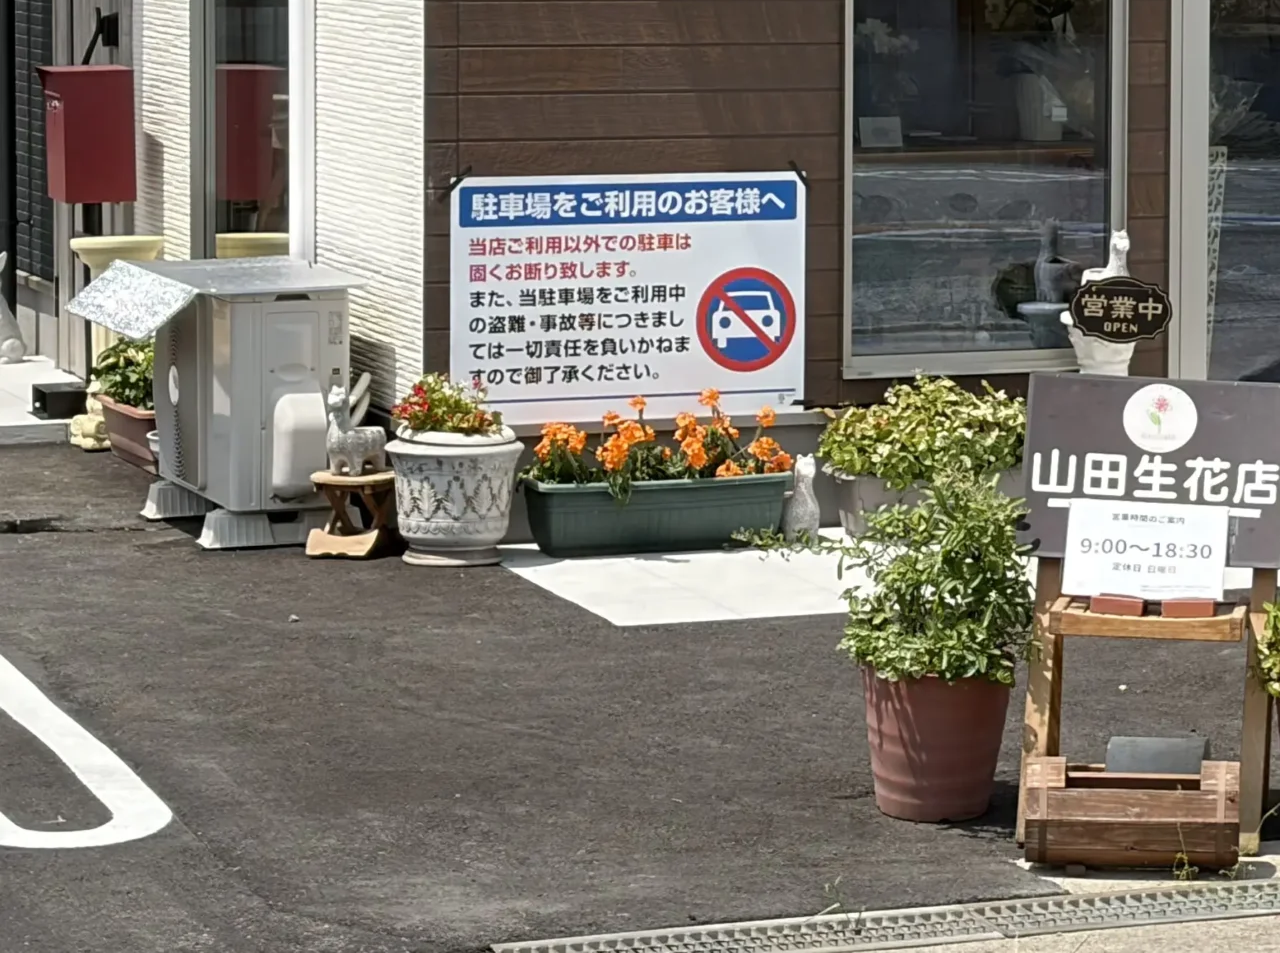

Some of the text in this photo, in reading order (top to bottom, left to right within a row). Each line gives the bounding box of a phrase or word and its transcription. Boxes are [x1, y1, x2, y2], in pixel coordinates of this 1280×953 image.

[471, 187, 786, 221] 駐車場をご利用のお客様へ
[468, 233, 692, 257] 当店ご利用以外での駐車は
[468, 260, 637, 283] 固くお断り致します。
[469, 284, 687, 308] また、当駐車場をご利用中
[1081, 294, 1163, 321] 営業中
[468, 310, 684, 335] の盗難・事故等につきまし
[1103, 321, 1138, 334] OPEN
[468, 336, 691, 361] ては一切責任を負いかねま
[468, 363, 660, 386] すので御了承ください。
[1031, 448, 1280, 505] 山田生花店
[1112, 513, 1185, 525] 営業時間のご案内
